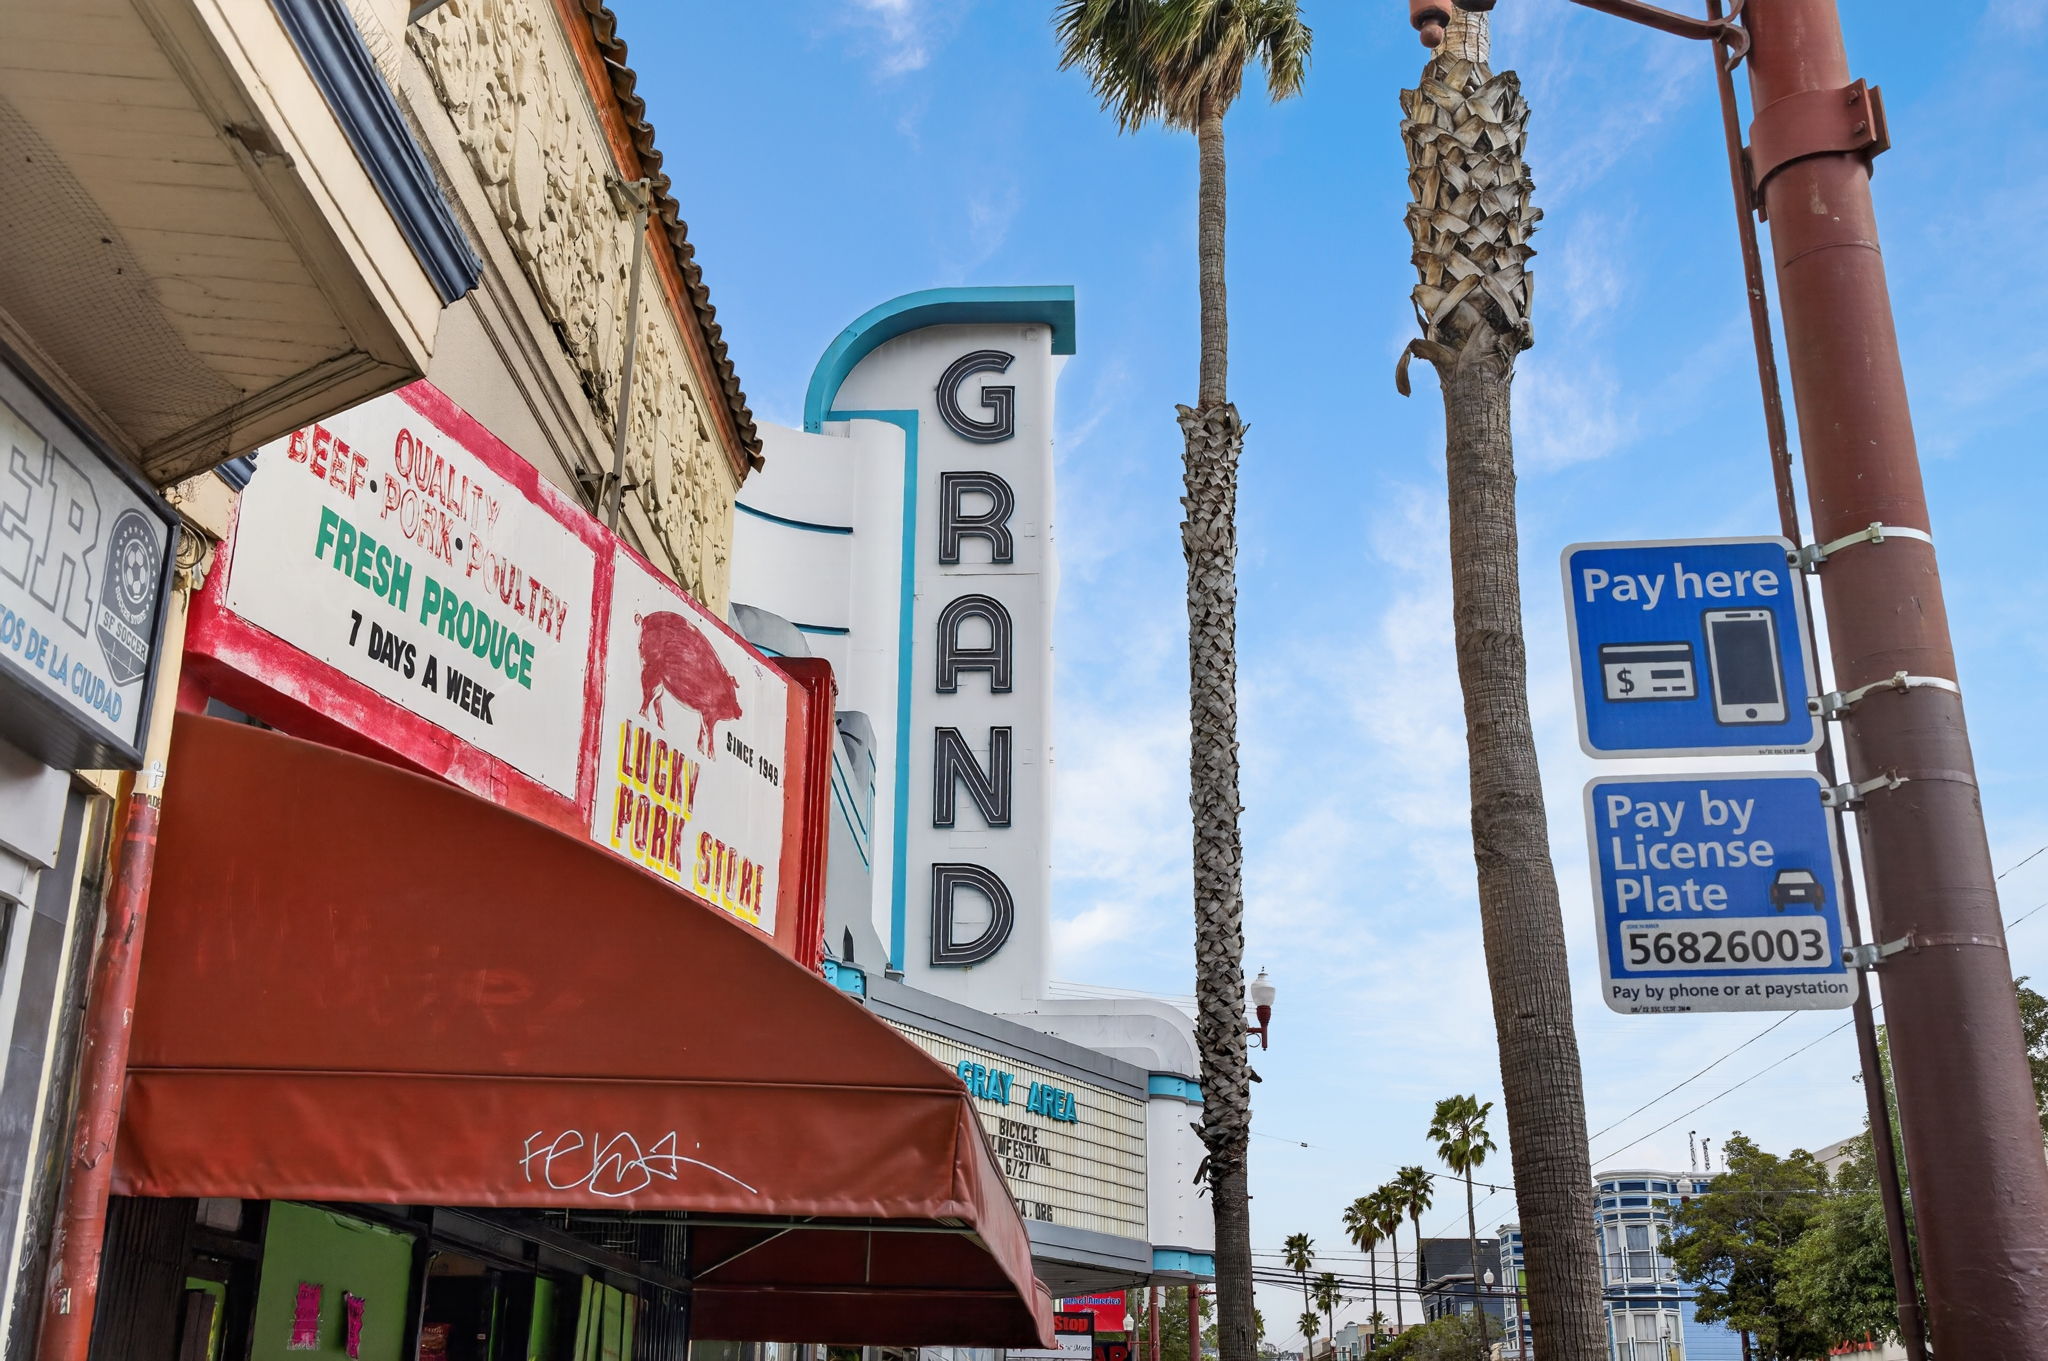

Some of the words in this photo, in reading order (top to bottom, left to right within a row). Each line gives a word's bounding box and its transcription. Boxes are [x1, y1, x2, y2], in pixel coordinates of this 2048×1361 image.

[394, 427, 502, 534] QUALITY
[287, 423, 370, 500] BEEF
[380, 472, 455, 567] PORK
[465, 532, 570, 643] POULTRY
[314, 504, 413, 613] FRESH
[419, 575, 536, 691] PRODUCE
[1582, 567, 1666, 612] Pay
[1673, 561, 1780, 600] here
[103, 610, 115, 630] SF
[116, 623, 147, 661] SOCCER
[930, 349, 1015, 968] GRAND
[24, 626, 49, 670] DE
[48, 644, 69, 687] LA
[71, 661, 123, 723] CIUDAD
[348, 609, 363, 647] 7
[368, 621, 417, 680] DAYS
[421, 654, 438, 694] A
[446, 666, 496, 726] WEEK
[618, 718, 700, 821] LUCKY
[726, 731, 754, 769] SINCE
[758, 755, 779, 787] 1949
[1606, 794, 1685, 837] Pay
[1700, 789, 1755, 835] by
[611, 783, 686, 882] PORK
[693, 831, 765, 926] STORE
[1612, 834, 1775, 871] License
[1615, 875, 1729, 914] Plate
[1628, 928, 1825, 966] 56826003
[1612, 985, 1640, 1001] Pay
[1645, 984, 1664, 1001] by
[1669, 983, 1720, 1001] phone
[1723, 985, 1740, 996] or
[1745, 982, 1762, 996] at
[1765, 980, 1849, 999] paystation
[957, 1060, 1015, 1106] GRAY
[1026, 1081, 1079, 1124] AREA
[999, 1118, 1038, 1145] BICYCLE
[1005, 1158, 1031, 1180] 6/27
